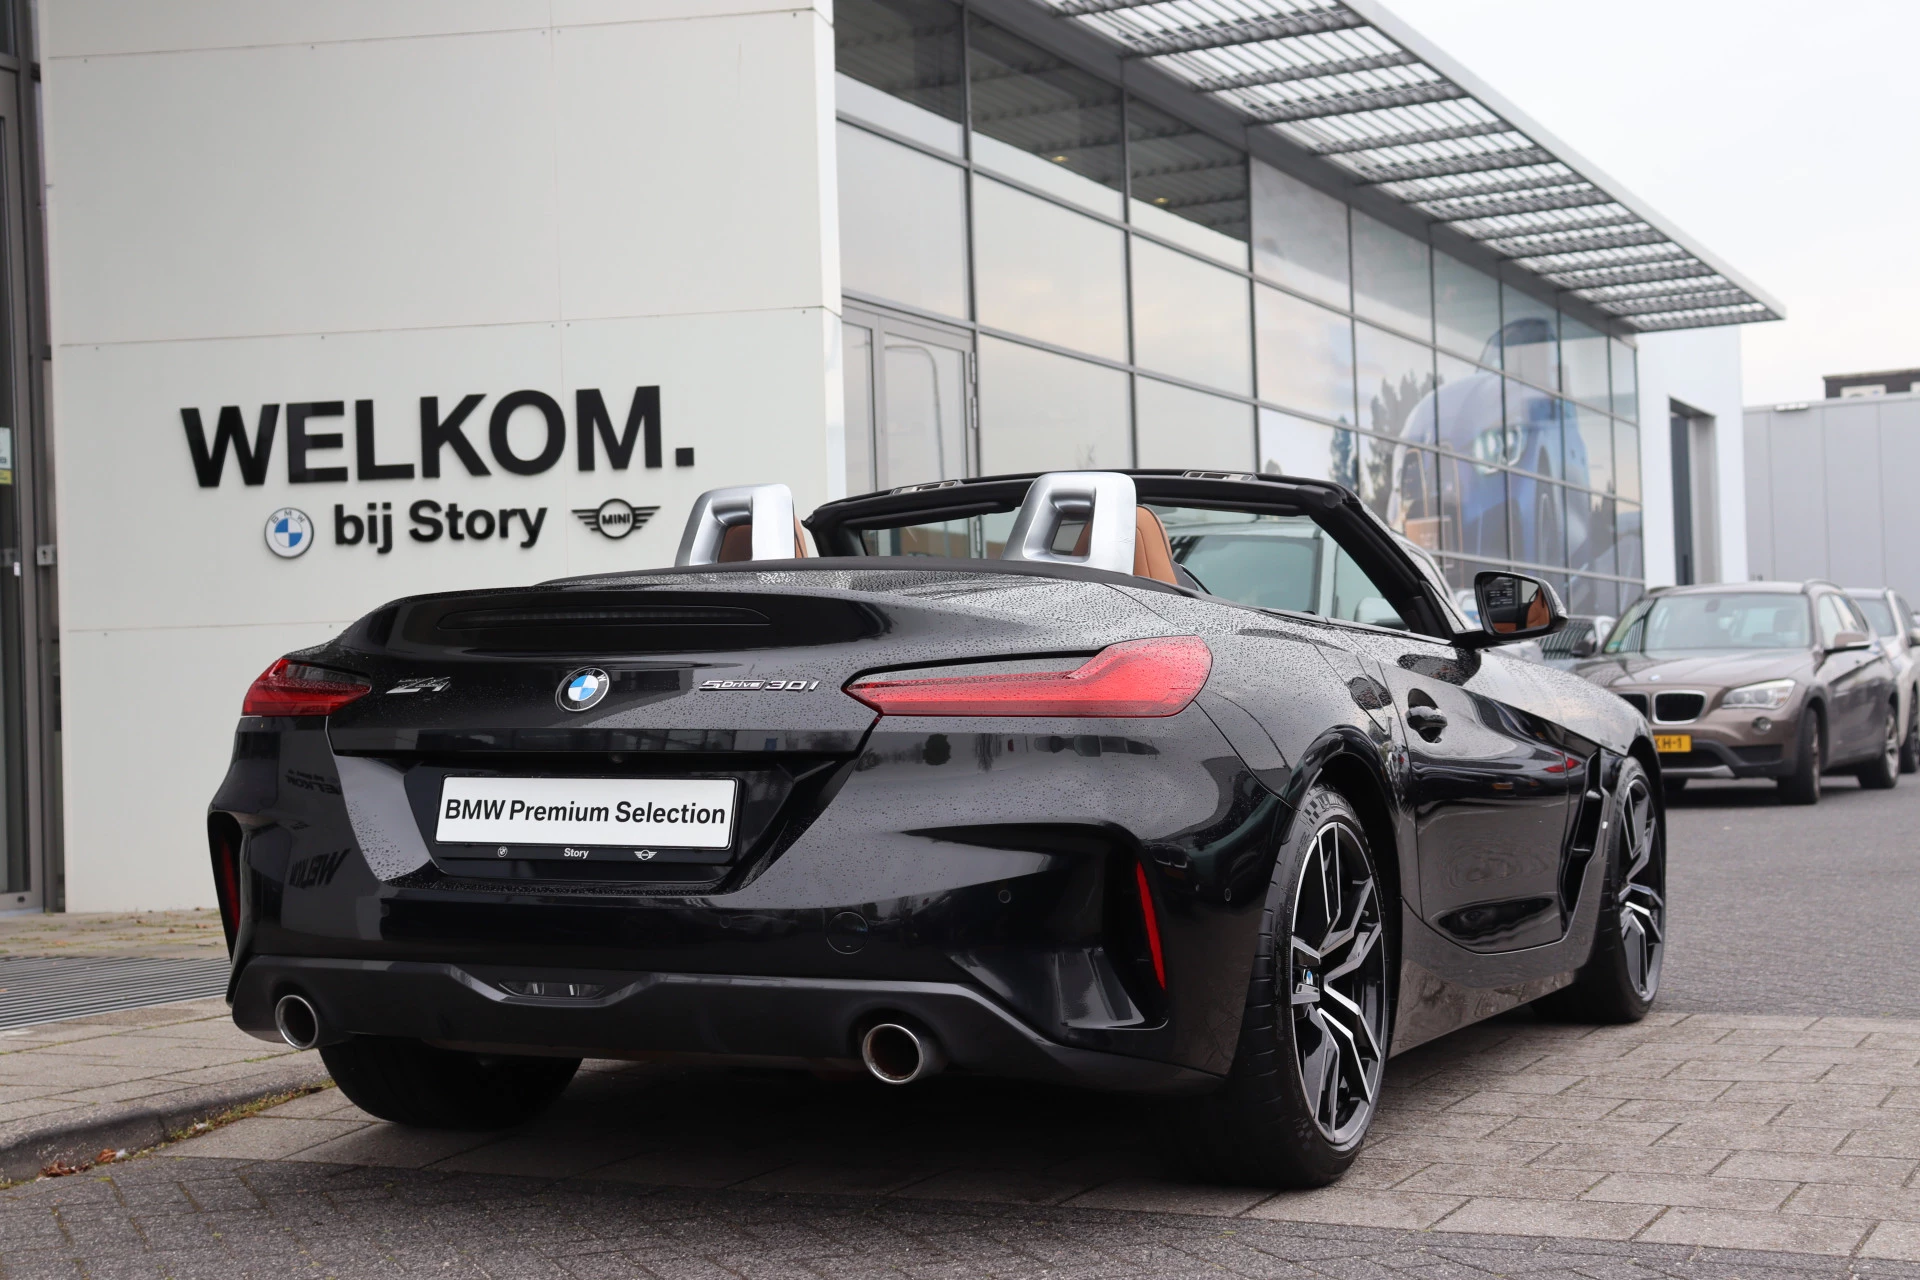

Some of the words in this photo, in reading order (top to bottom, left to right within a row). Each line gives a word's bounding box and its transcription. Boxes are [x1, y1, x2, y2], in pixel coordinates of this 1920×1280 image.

[180, 386, 694, 488] WELKOM.
[334, 502, 393, 554] bij
[409, 499, 547, 549] Story
[602, 513, 630, 525] MINI
[445, 799, 505, 820] BMW
[509, 800, 609, 823] Premium
[615, 801, 726, 824] Selection
[564, 848, 589, 859] Story
